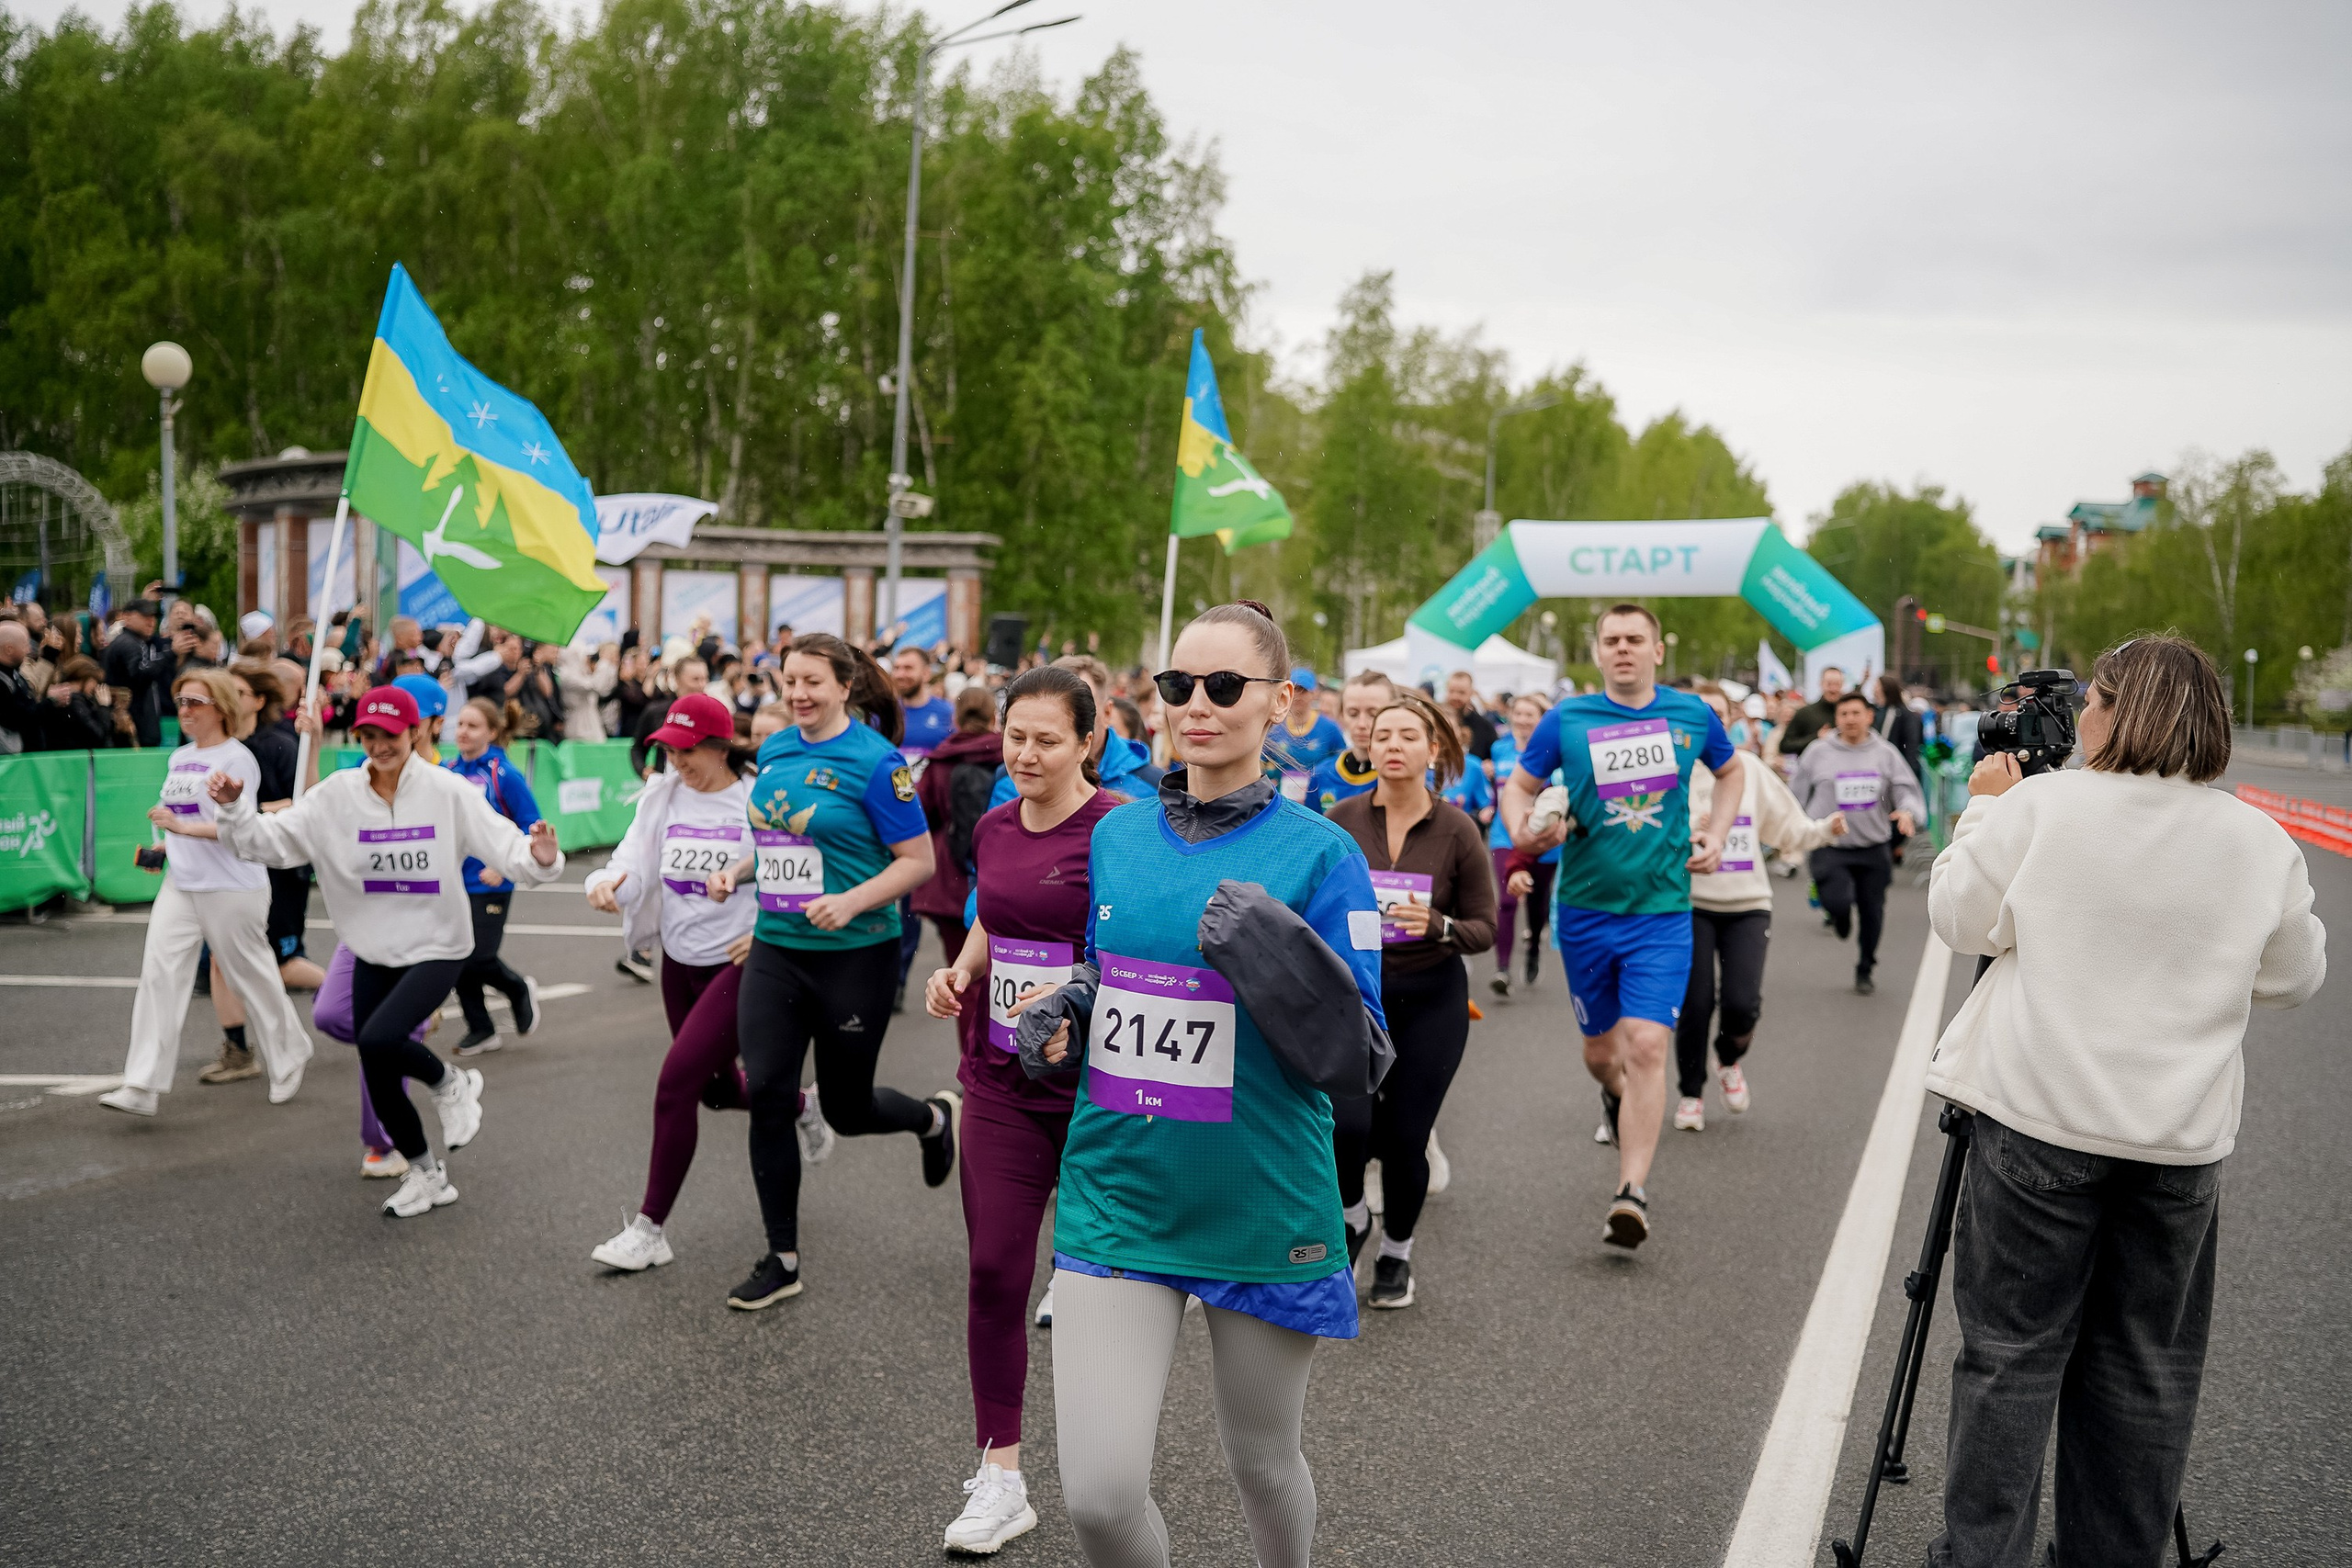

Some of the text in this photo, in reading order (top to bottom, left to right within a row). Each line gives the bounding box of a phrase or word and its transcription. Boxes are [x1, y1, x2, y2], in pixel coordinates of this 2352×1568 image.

[1568, 546, 1700, 575] СТАРТ
[1606, 745, 1664, 771] 2280
[1724, 834, 1749, 852] 95
[370, 851, 429, 872] 2108
[671, 849, 729, 872] 2229
[763, 858, 812, 881] 2004
[1119, 970, 1137, 979] СБЕР
[1104, 1008, 1216, 1064] 2147
